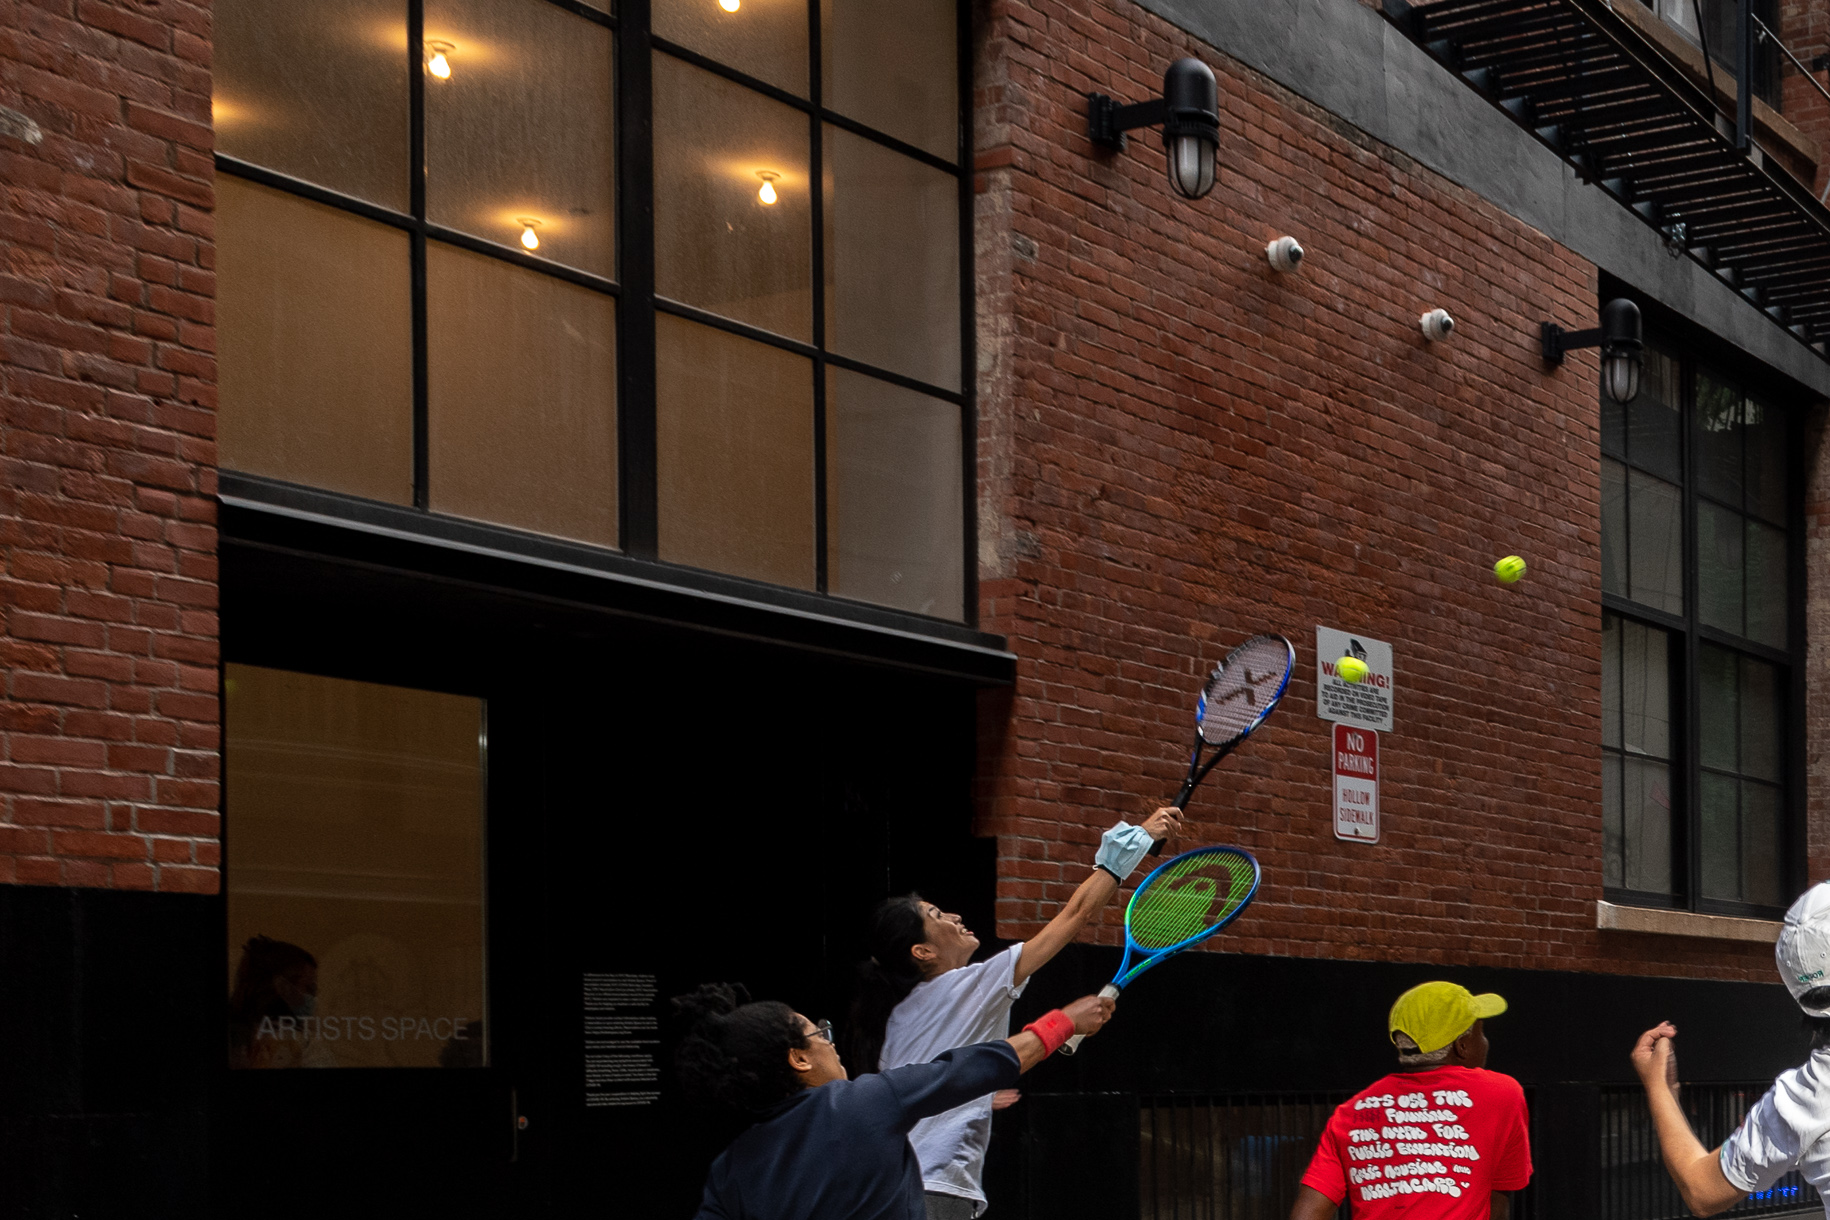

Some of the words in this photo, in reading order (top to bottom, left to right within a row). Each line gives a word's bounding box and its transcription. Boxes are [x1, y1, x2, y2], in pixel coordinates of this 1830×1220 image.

[1321, 660, 1390, 690] WAING!
[1346, 733, 1364, 754] NO
[1338, 752, 1374, 776] PARKING
[1342, 789, 1370, 806] HOLLOW
[1339, 807, 1374, 826] SIDEWALK
[256, 1015, 375, 1041] ARTISTS
[382, 1016, 469, 1041] SPACE
[1397, 1091, 1428, 1109] USE
[1432, 1089, 1473, 1108] THE
[1431, 1122, 1470, 1140] FOR
